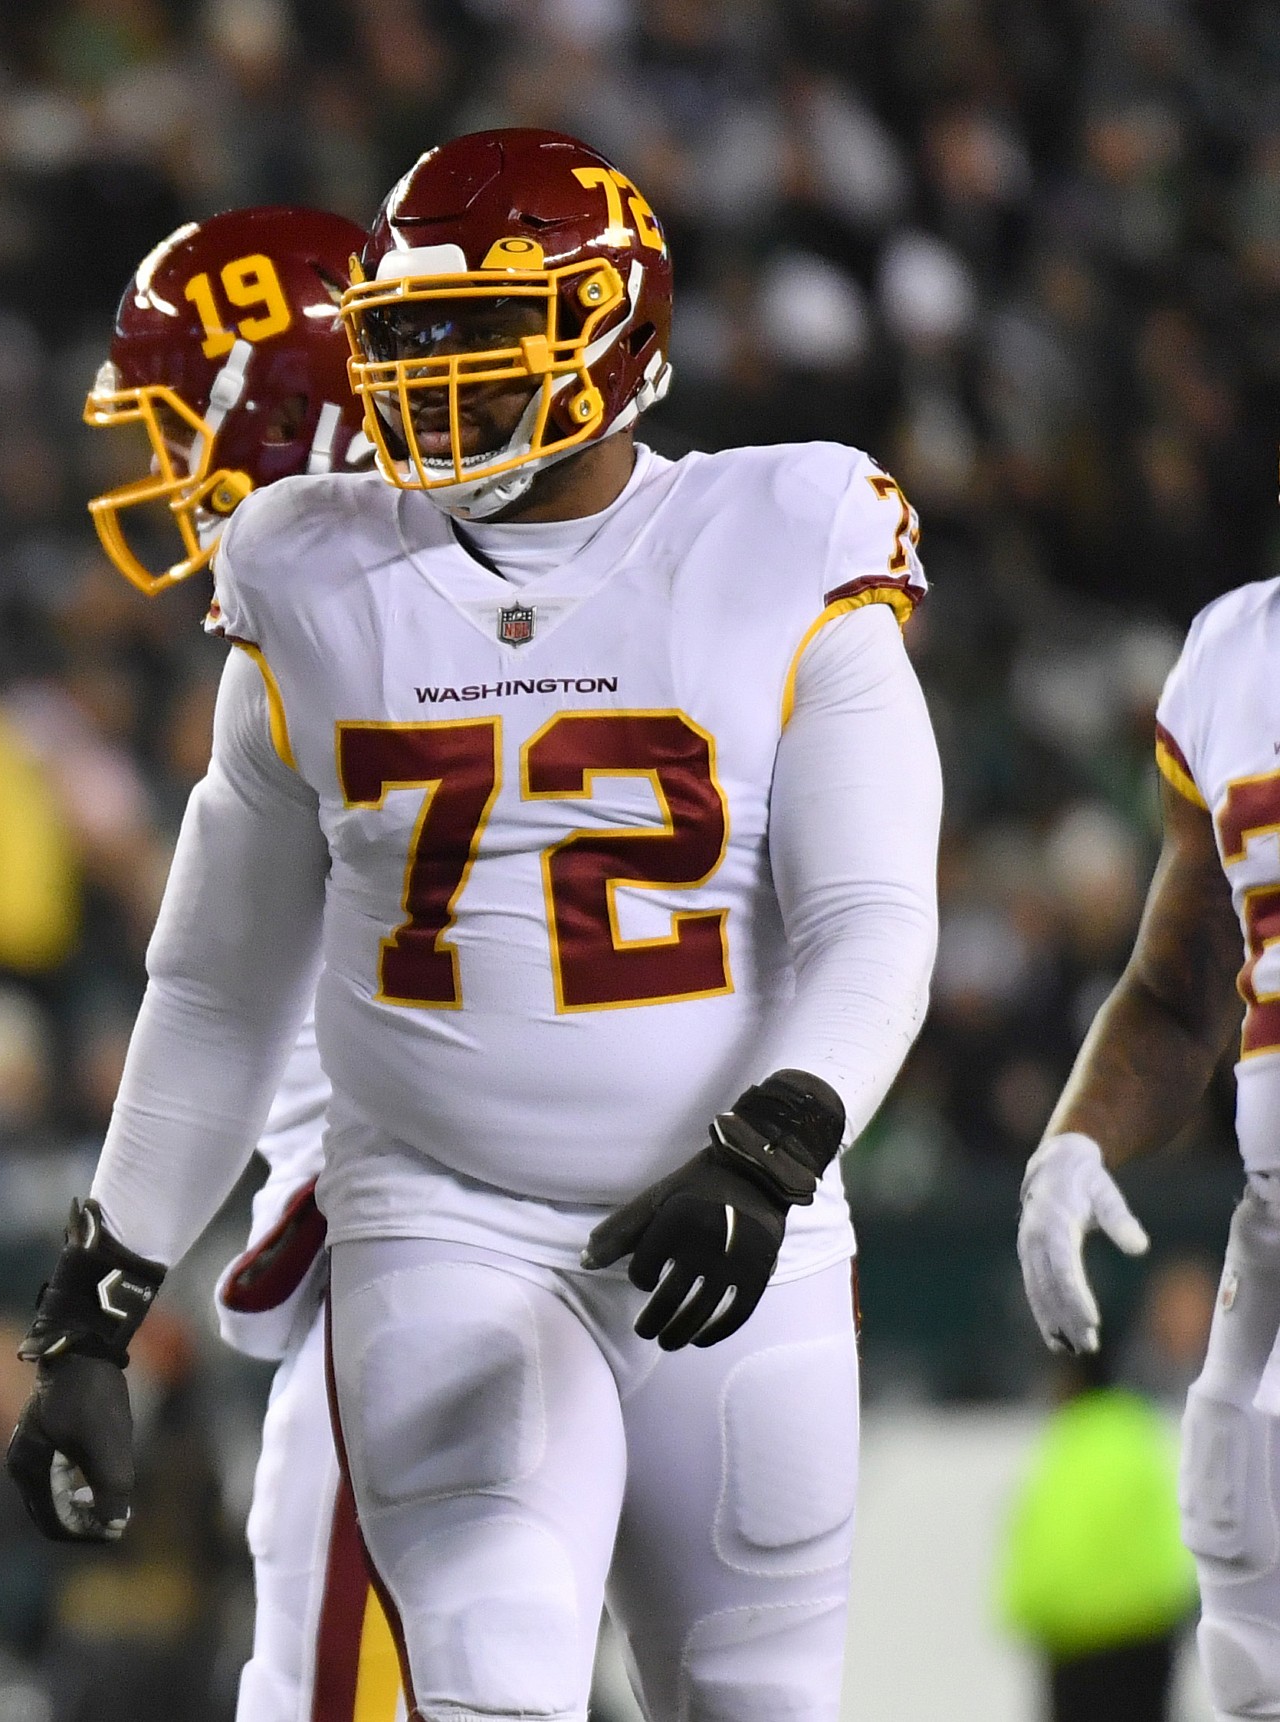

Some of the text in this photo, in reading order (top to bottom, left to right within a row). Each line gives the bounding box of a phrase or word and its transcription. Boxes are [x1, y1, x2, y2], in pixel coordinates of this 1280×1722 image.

[571, 167, 663, 251] 72
[184, 253, 291, 359] 19
[414, 676, 618, 704] WASHINGTON
[335, 708, 735, 1014] 72
